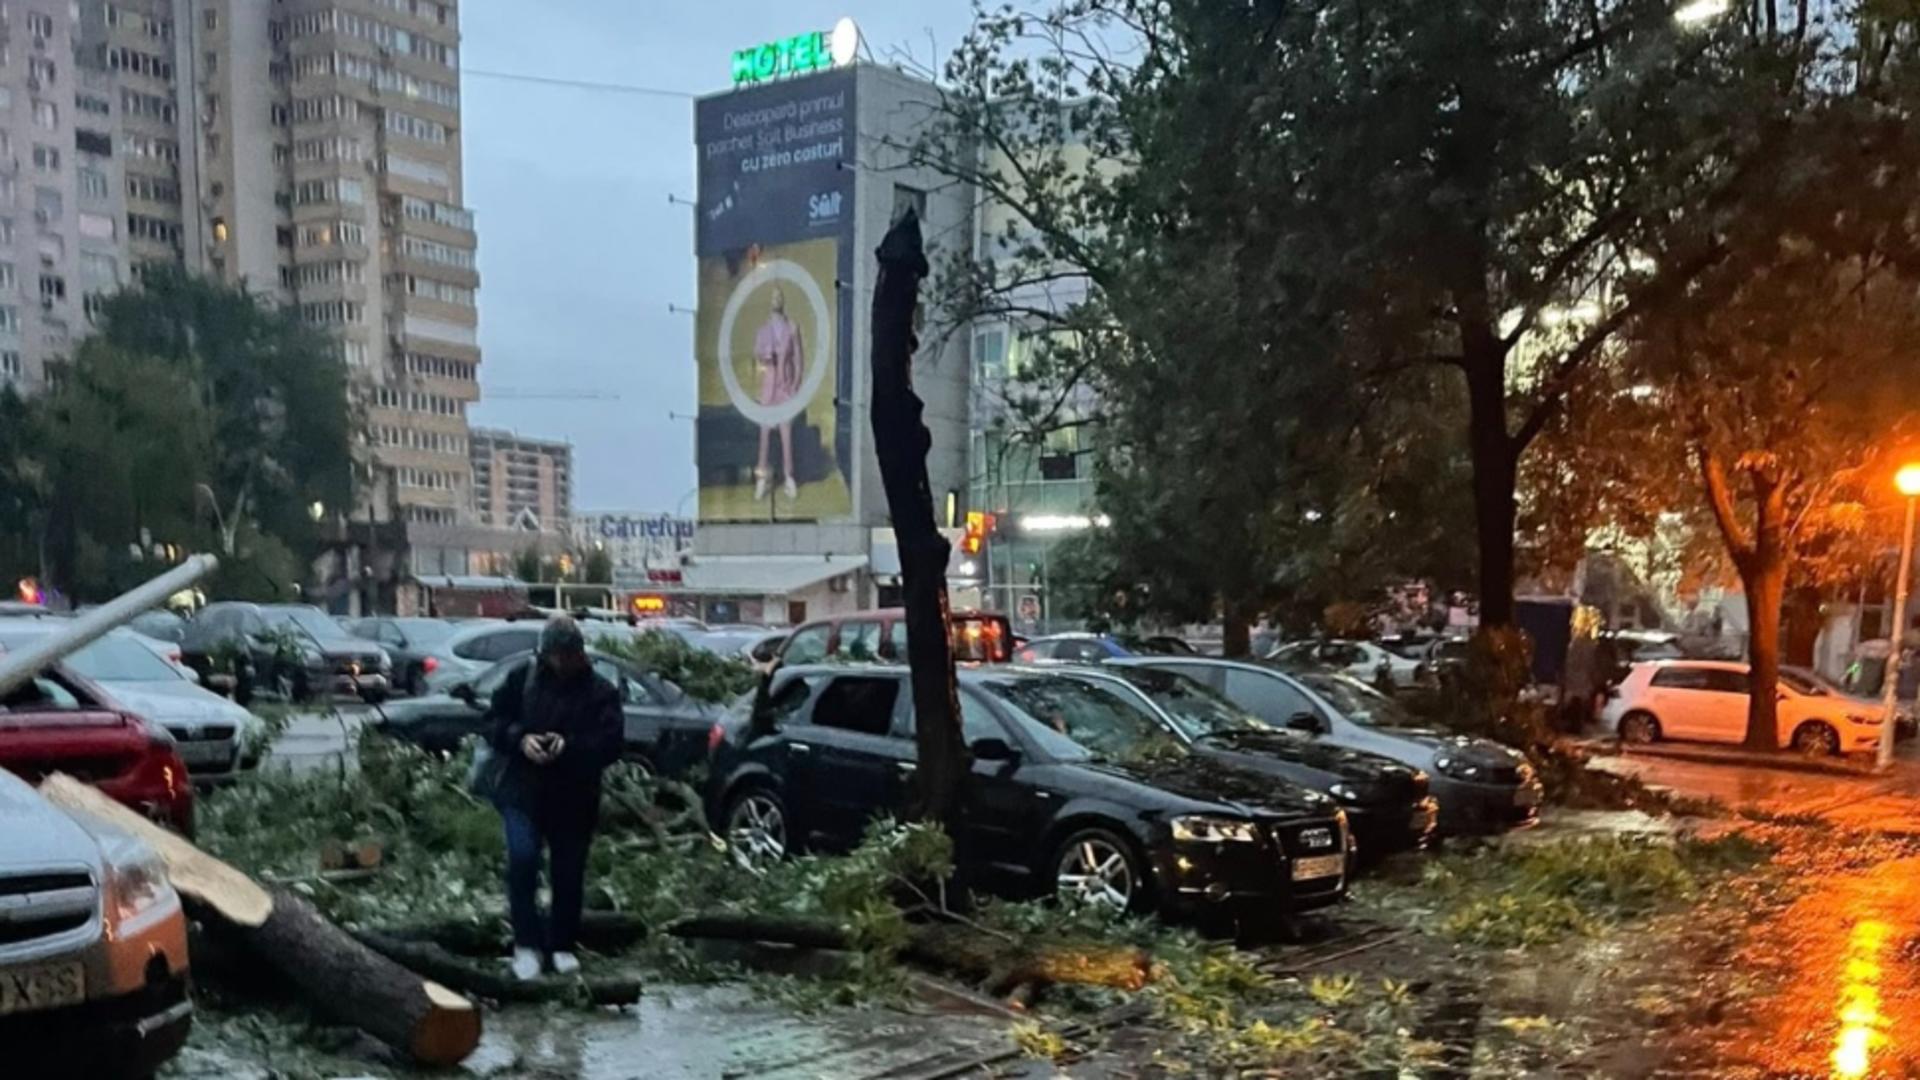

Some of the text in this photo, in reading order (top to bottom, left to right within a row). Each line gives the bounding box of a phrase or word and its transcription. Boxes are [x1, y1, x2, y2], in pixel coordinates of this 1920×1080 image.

[731, 32, 831, 82] HOTEL
[800, 90, 845, 122] primul
[785, 118, 843, 142] Business
[741, 136, 843, 172] cu zero costuri
[600, 513, 694, 538] Carrefou
